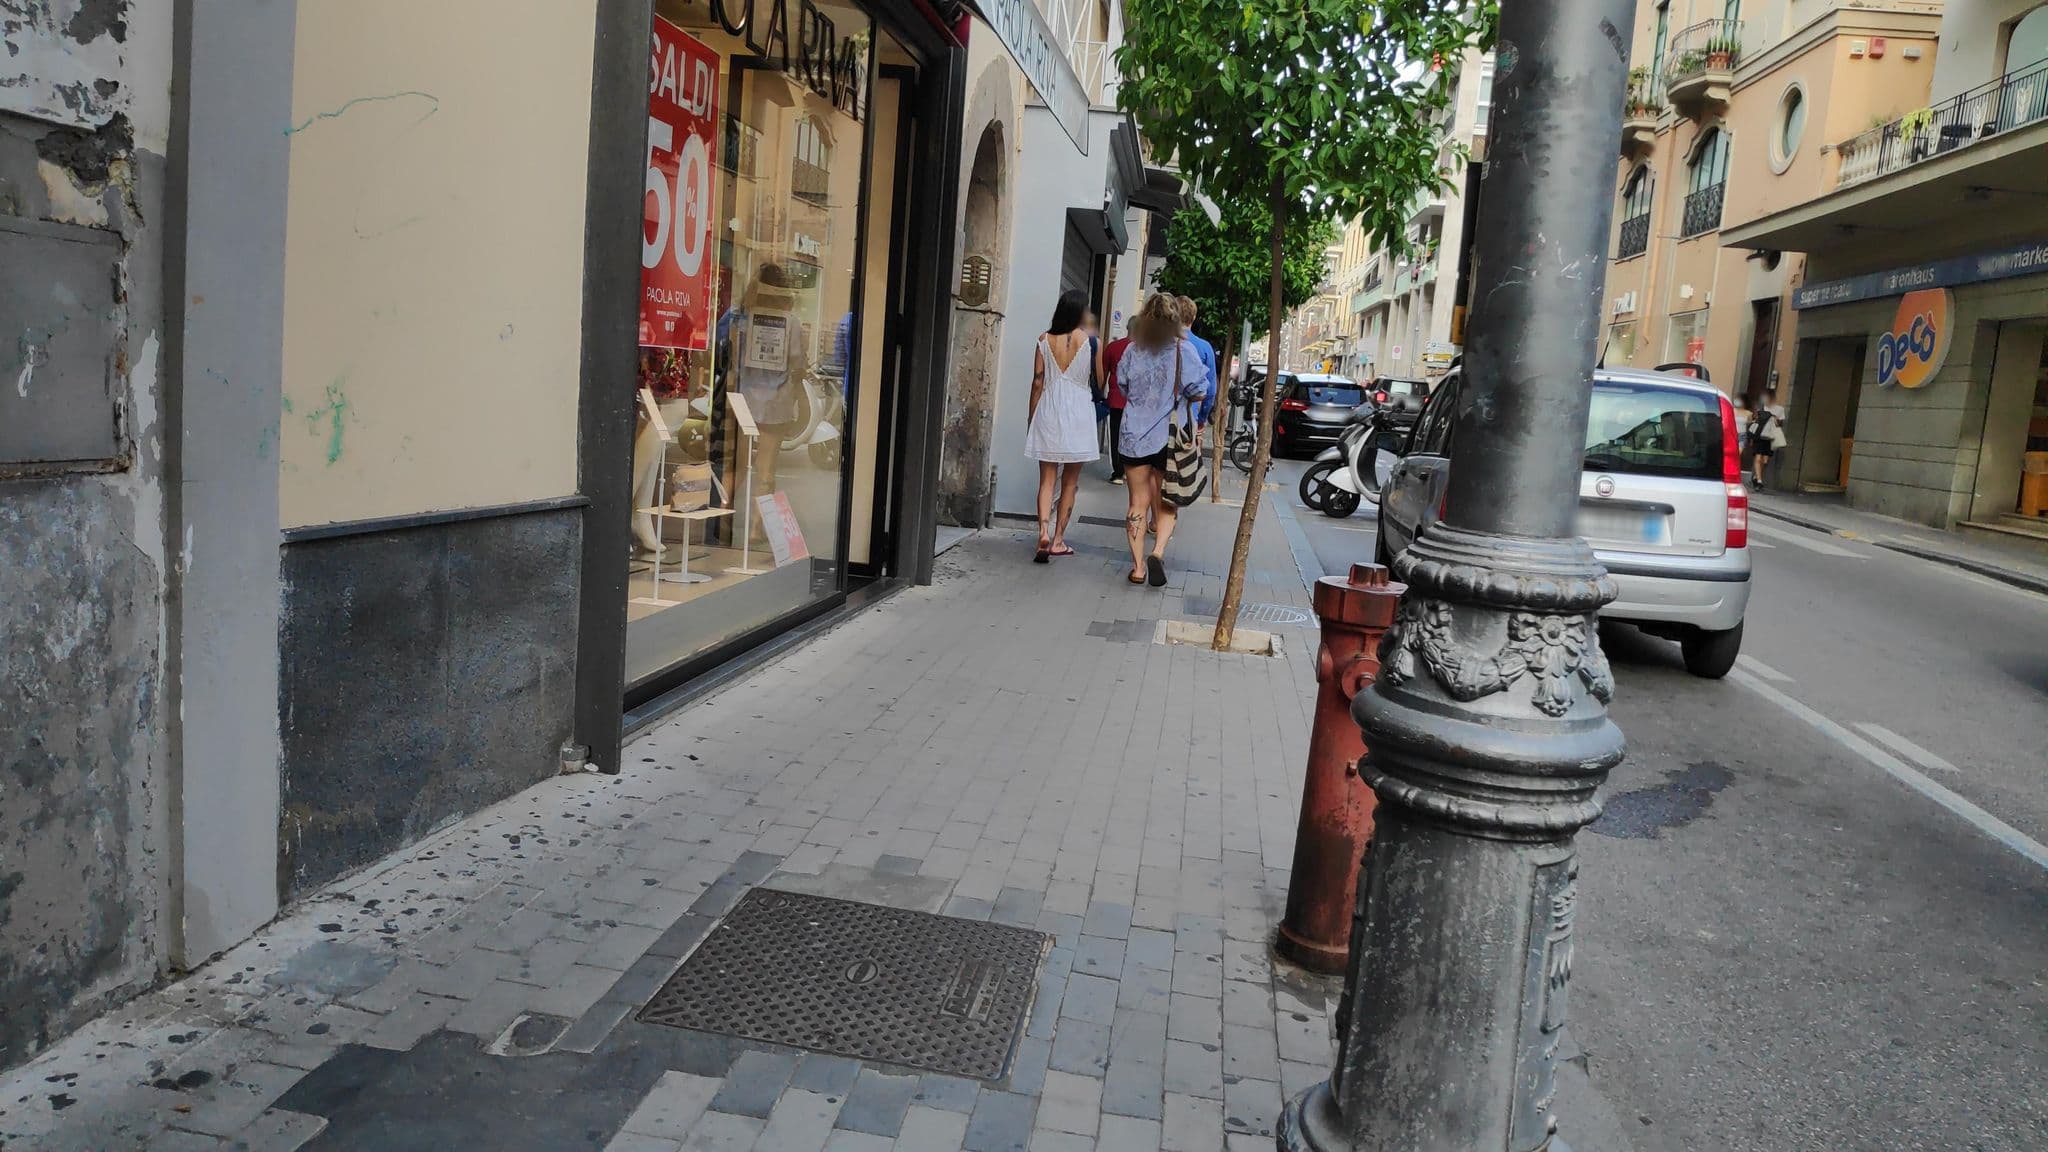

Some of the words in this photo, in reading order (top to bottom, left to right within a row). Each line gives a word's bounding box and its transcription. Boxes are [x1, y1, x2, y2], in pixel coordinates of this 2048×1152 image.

[650, 32, 714, 121] SALDI
[796, 0, 859, 121] RIVA
[1035, 32, 1057, 111] RIVA
[642, 116, 709, 277] 50
[647, 286, 674, 304] PAOLA
[675, 290, 691, 307] RIVA
[1884, 266, 1935, 289] arenhaus
